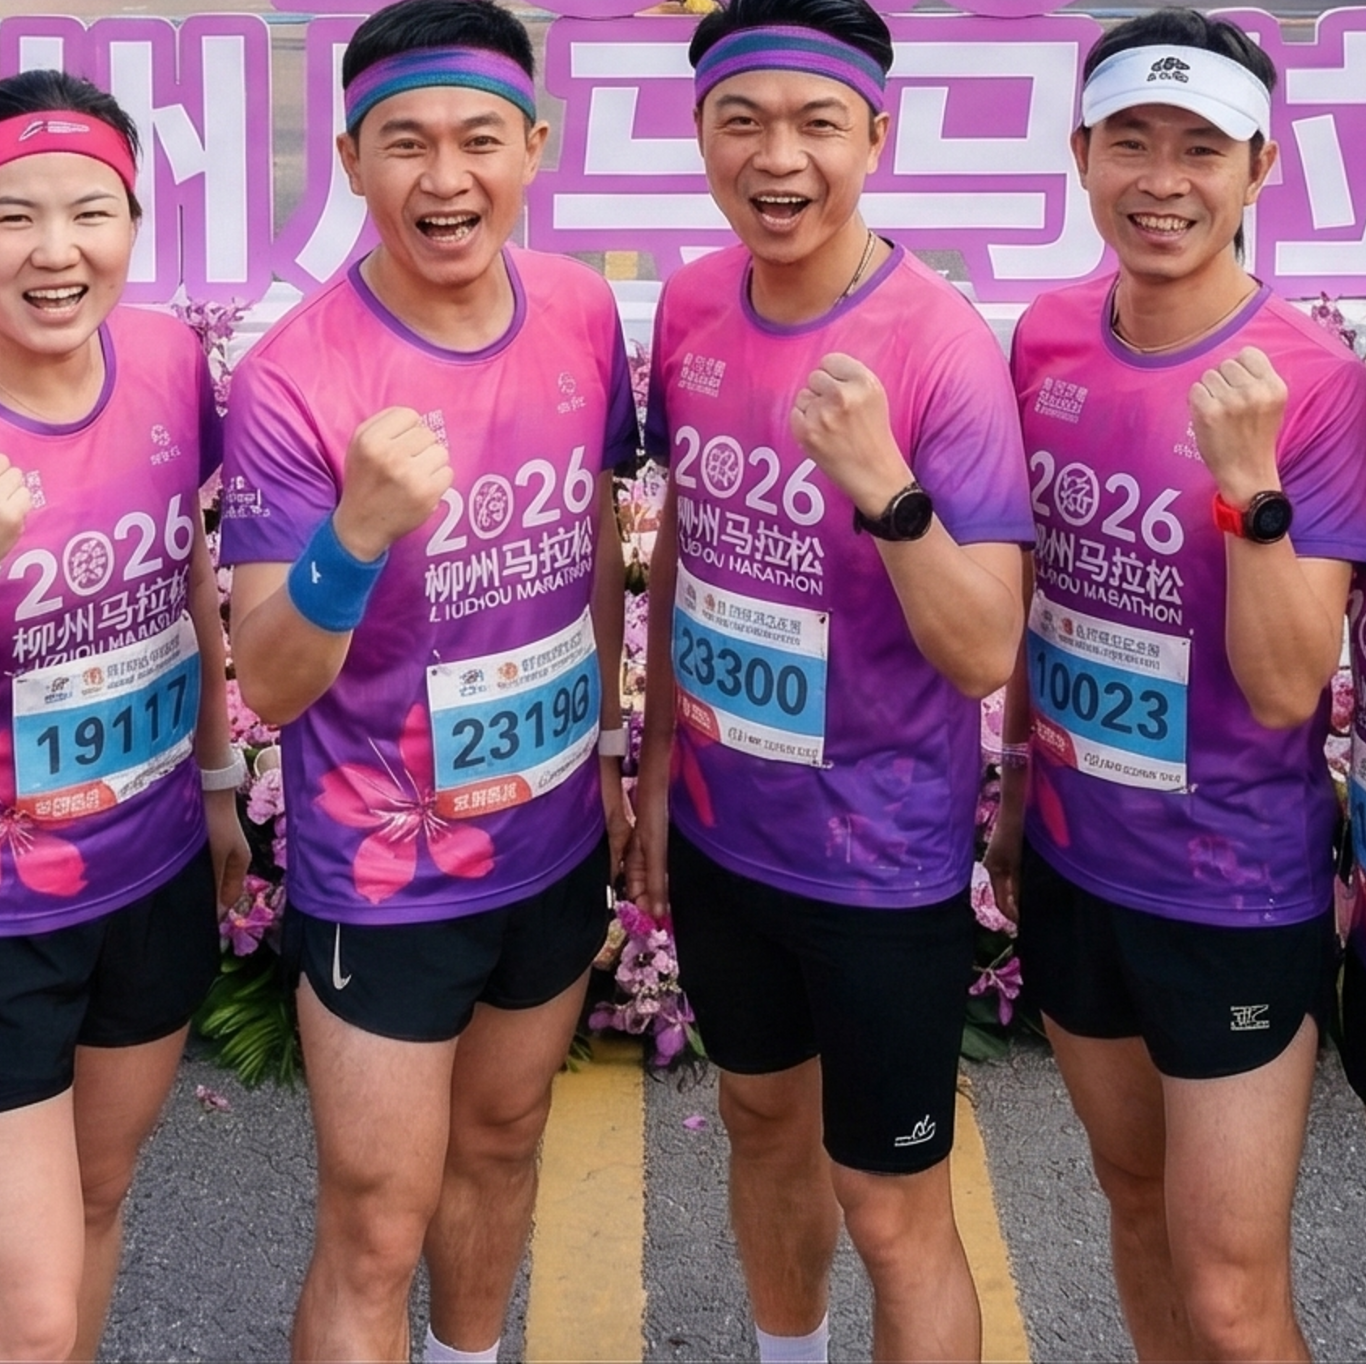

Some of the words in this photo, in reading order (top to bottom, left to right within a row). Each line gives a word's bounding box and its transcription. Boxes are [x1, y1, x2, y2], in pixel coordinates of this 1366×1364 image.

[426, 446, 596, 556] 2026
[674, 426, 825, 526] 2026
[1029, 450, 1184, 555] 2026
[7, 493, 195, 622] 2026
[678, 626, 808, 716] 23300
[1037, 651, 1169, 741] 10023
[37, 672, 188, 775] 19117
